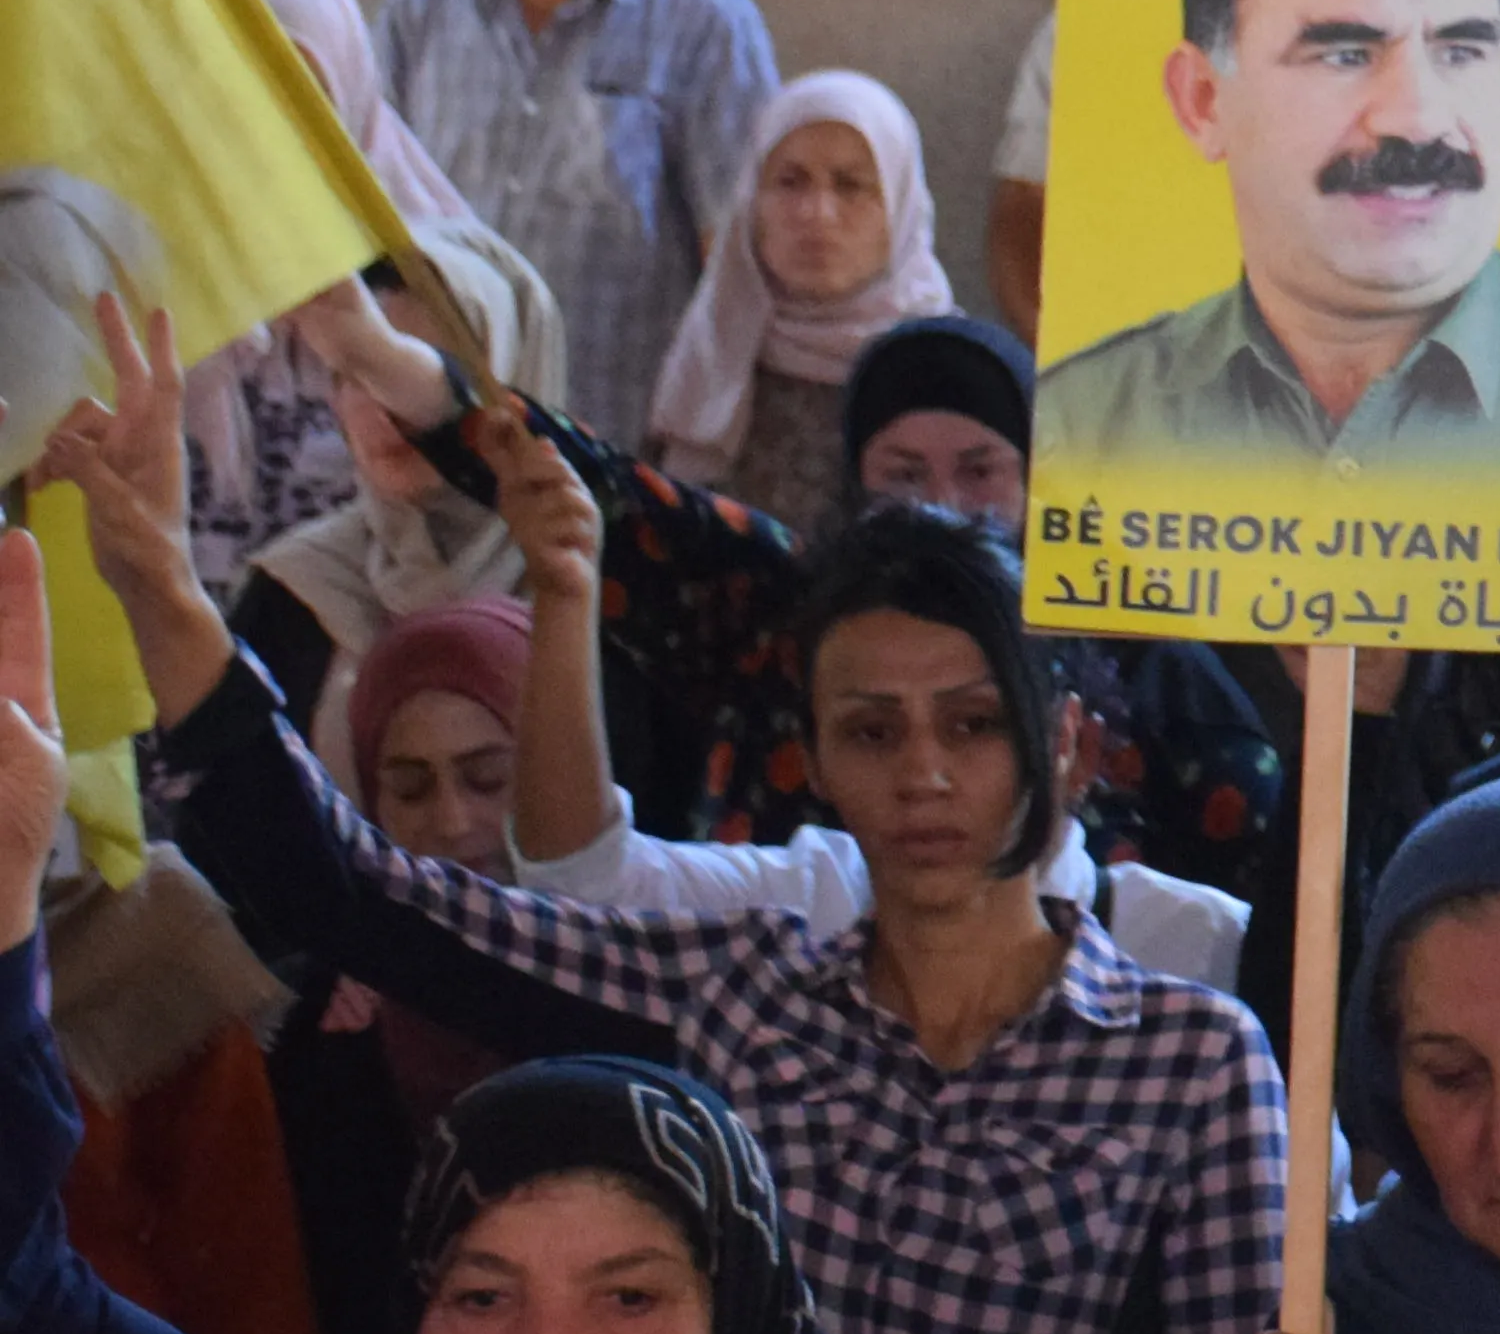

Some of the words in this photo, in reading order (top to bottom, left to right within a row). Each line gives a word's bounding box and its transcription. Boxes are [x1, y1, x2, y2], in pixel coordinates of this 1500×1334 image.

[1042, 495, 1104, 546] BÊ
[1120, 509, 1303, 555] SEROK
[1316, 520, 1480, 562] JIYAN
[1044, 559, 1220, 616] القائد
[1250, 576, 1408, 641] بدون
